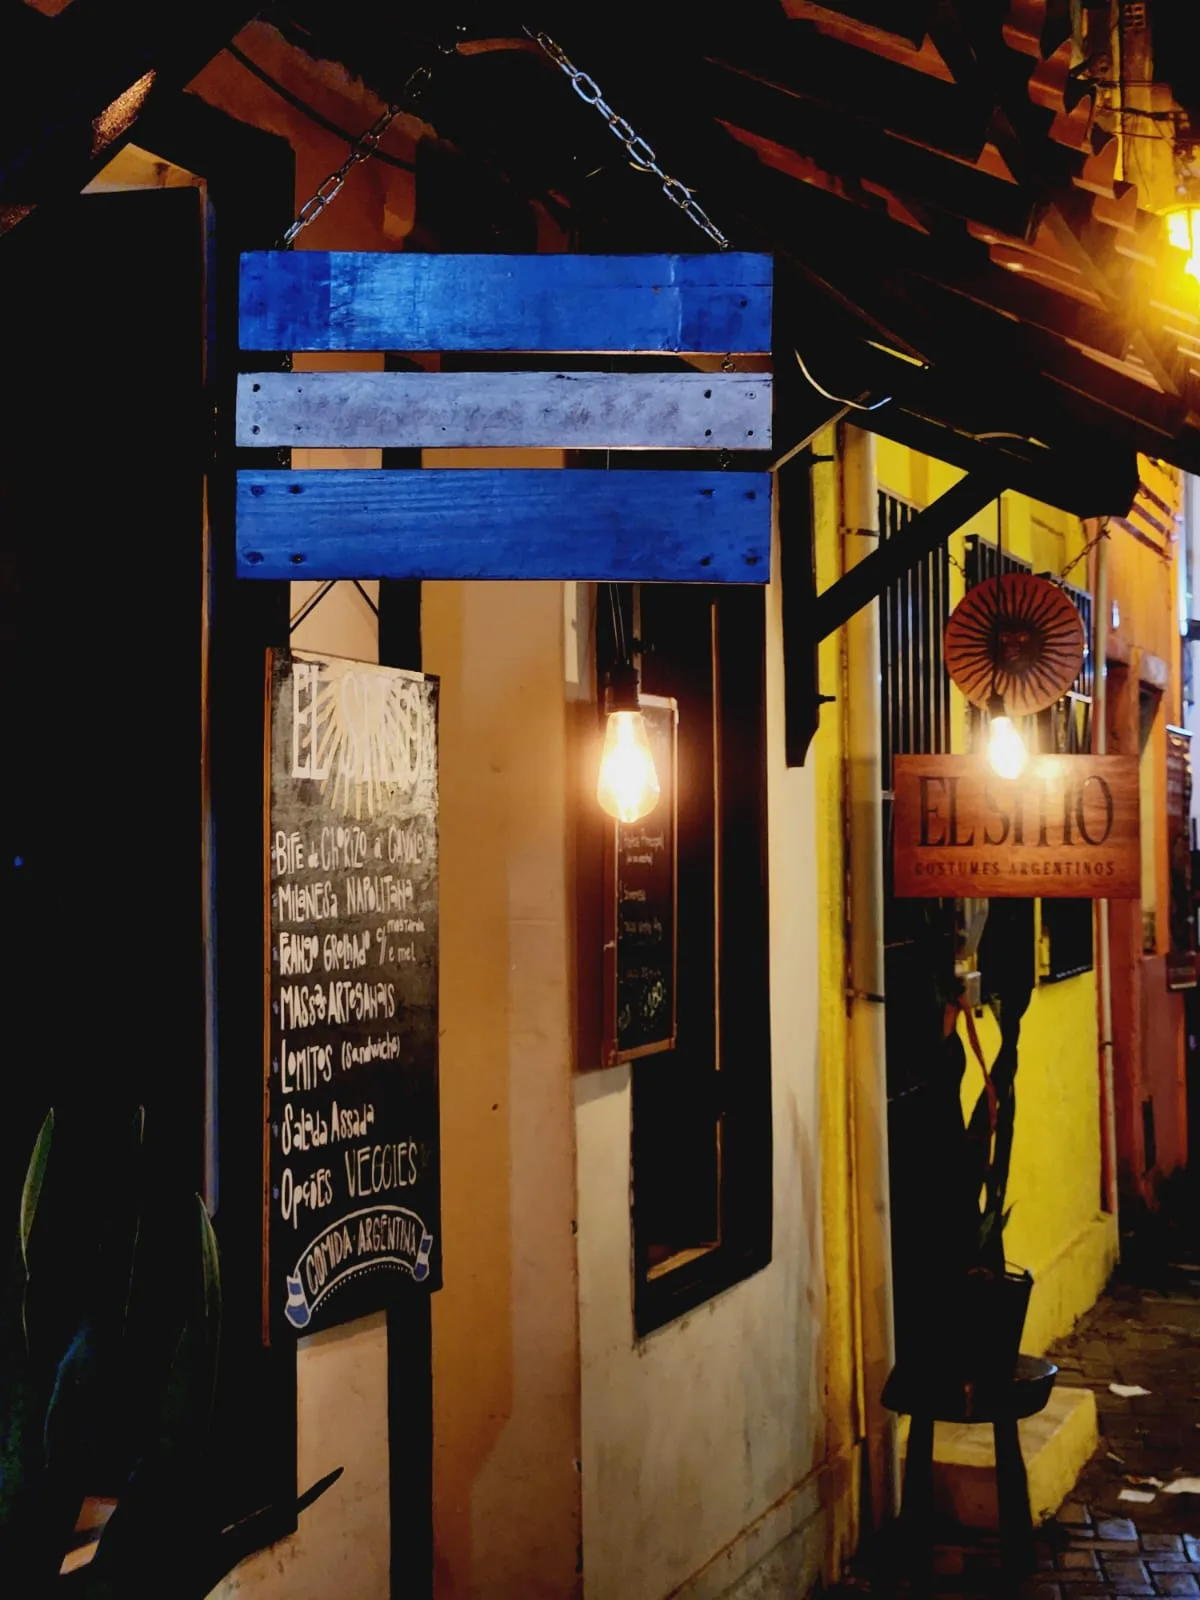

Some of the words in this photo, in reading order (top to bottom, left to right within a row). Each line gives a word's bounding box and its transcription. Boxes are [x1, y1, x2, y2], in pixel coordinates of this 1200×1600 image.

[917, 775, 975, 847] EL
[275, 830, 304, 875] BIFE
[1007, 862, 1116, 876] ARGENTINOS
[344, 1141, 418, 1198] VEGGIES
[305, 1225, 353, 1295] COMIDA
[357, 1214, 417, 1257] ARGENTINA
